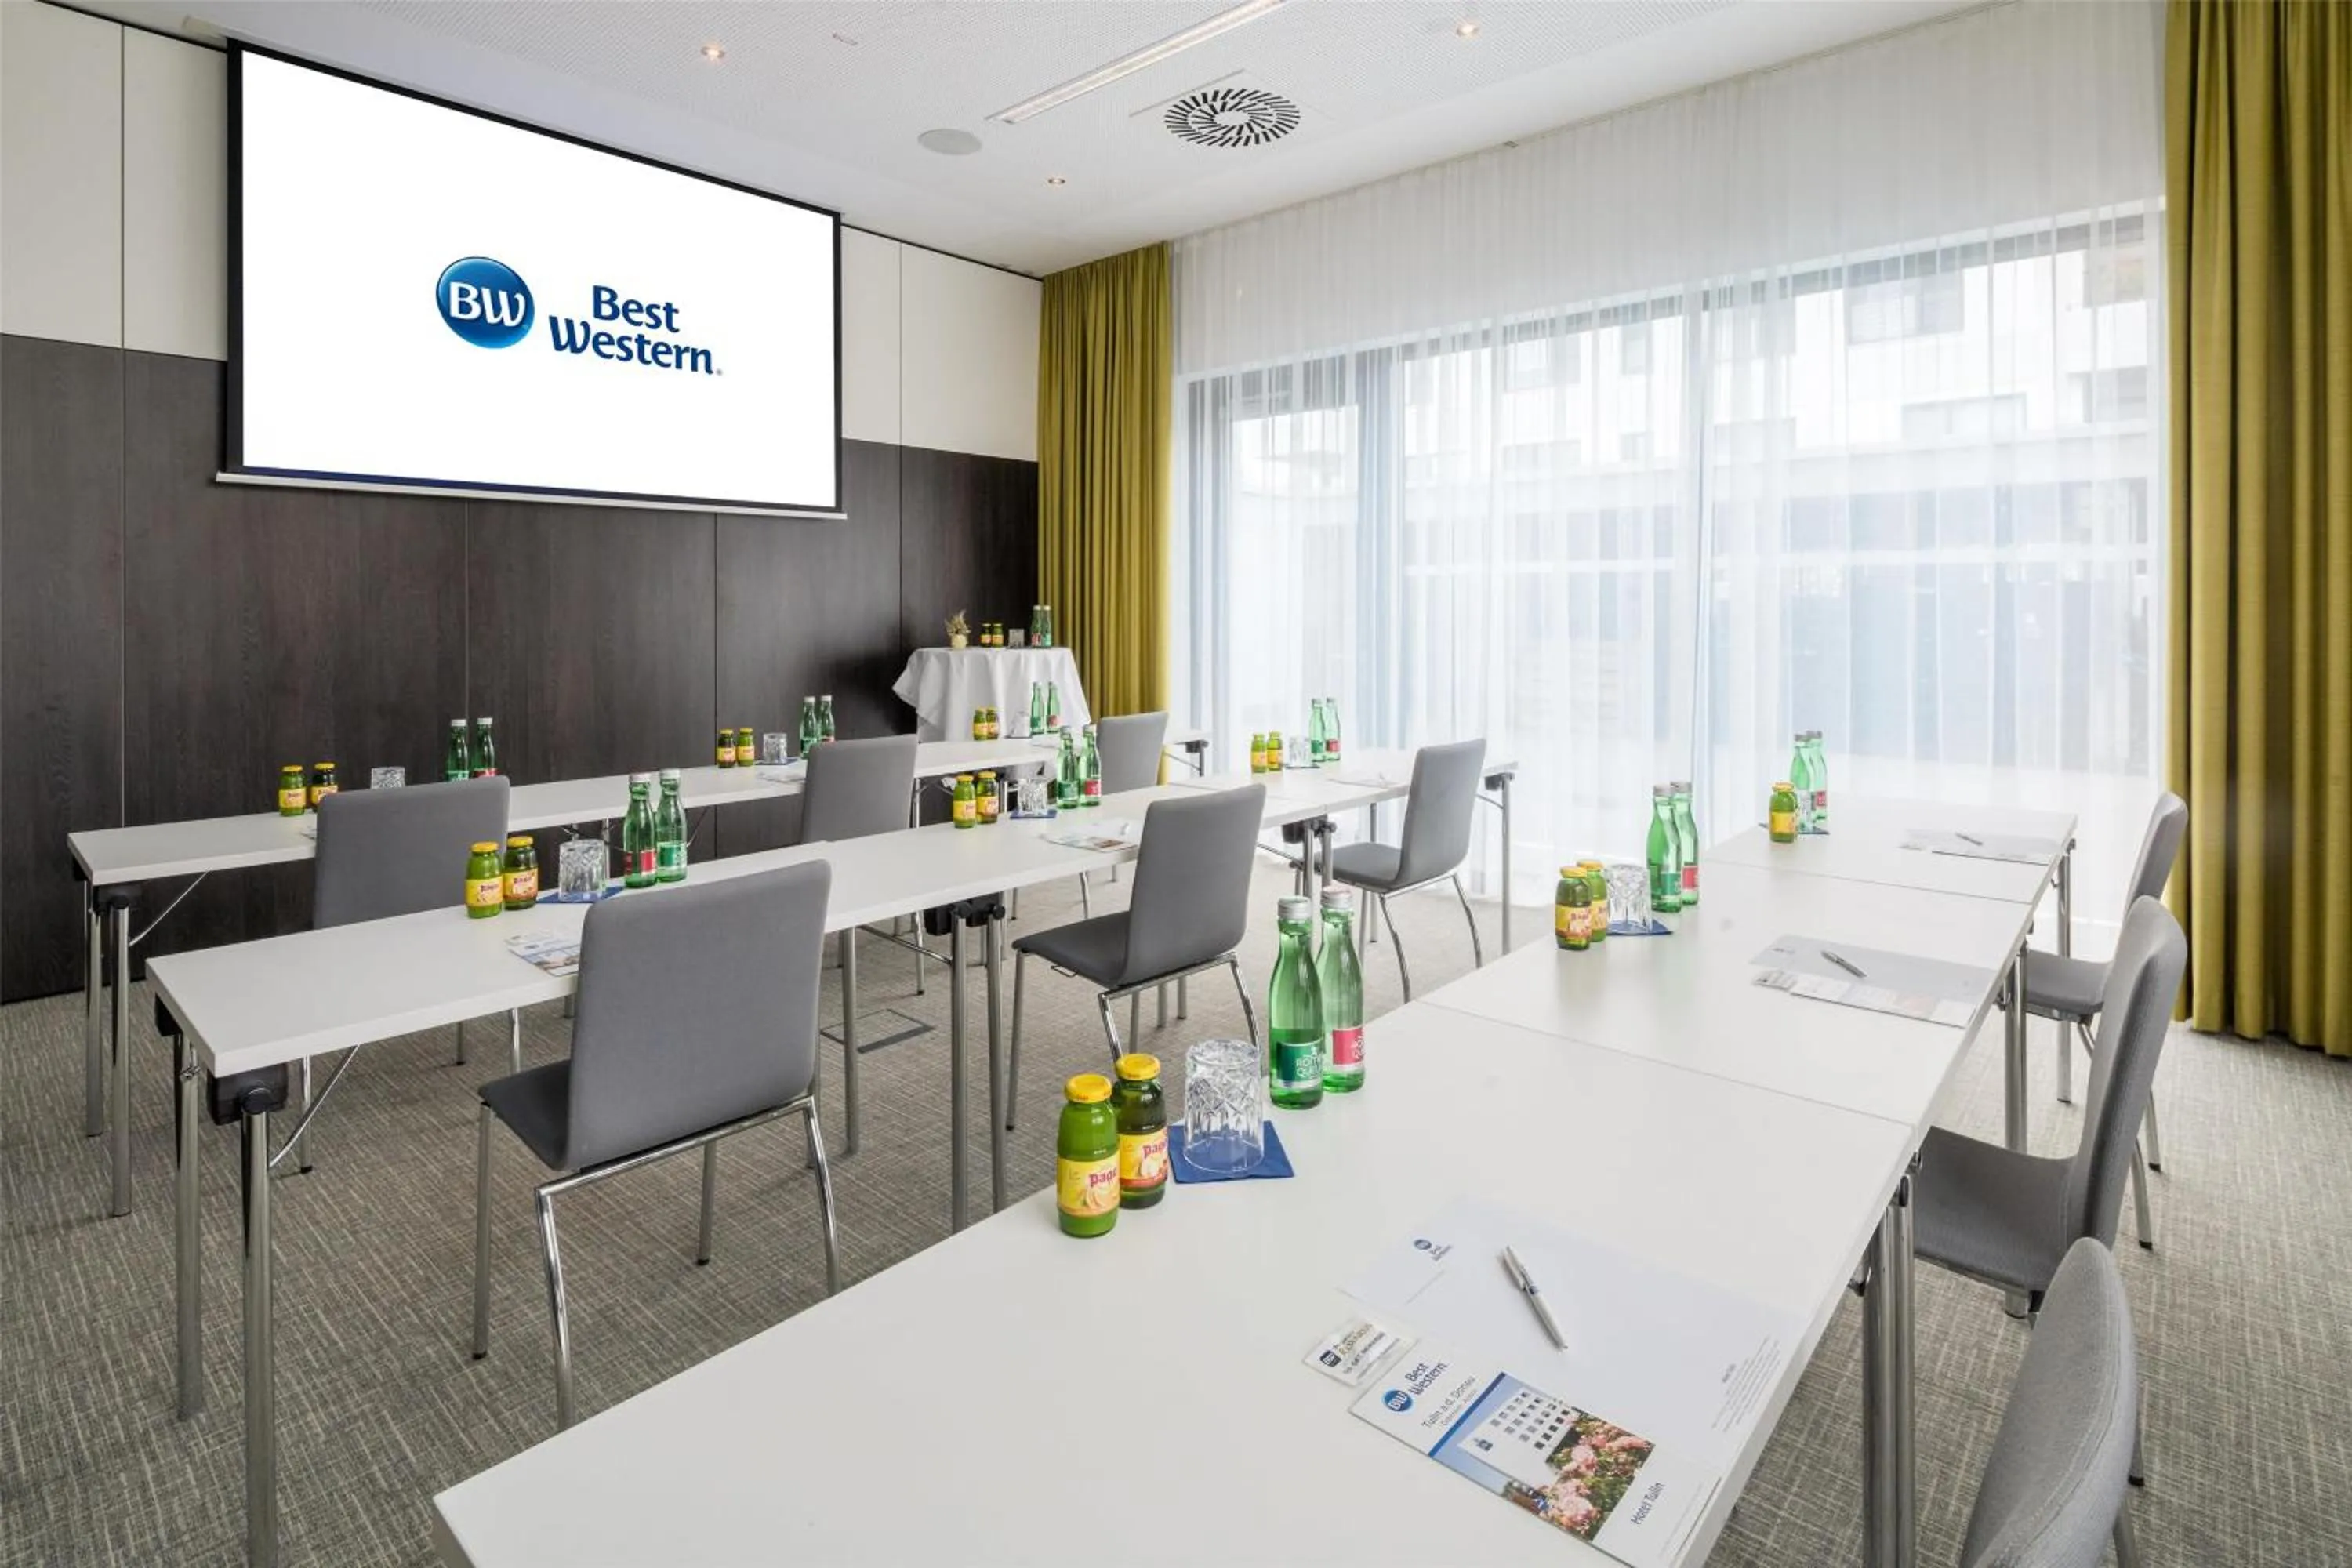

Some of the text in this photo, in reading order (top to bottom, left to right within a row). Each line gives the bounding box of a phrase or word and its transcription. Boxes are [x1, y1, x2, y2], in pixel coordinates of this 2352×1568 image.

[448, 281, 526, 327] BW
[592, 285, 680, 332] Best
[549, 315, 714, 375] Western
[1405, 1363, 1428, 1381] Best
[1408, 1363, 1447, 1395] Western
[1631, 1501, 1652, 1524] Hotel
